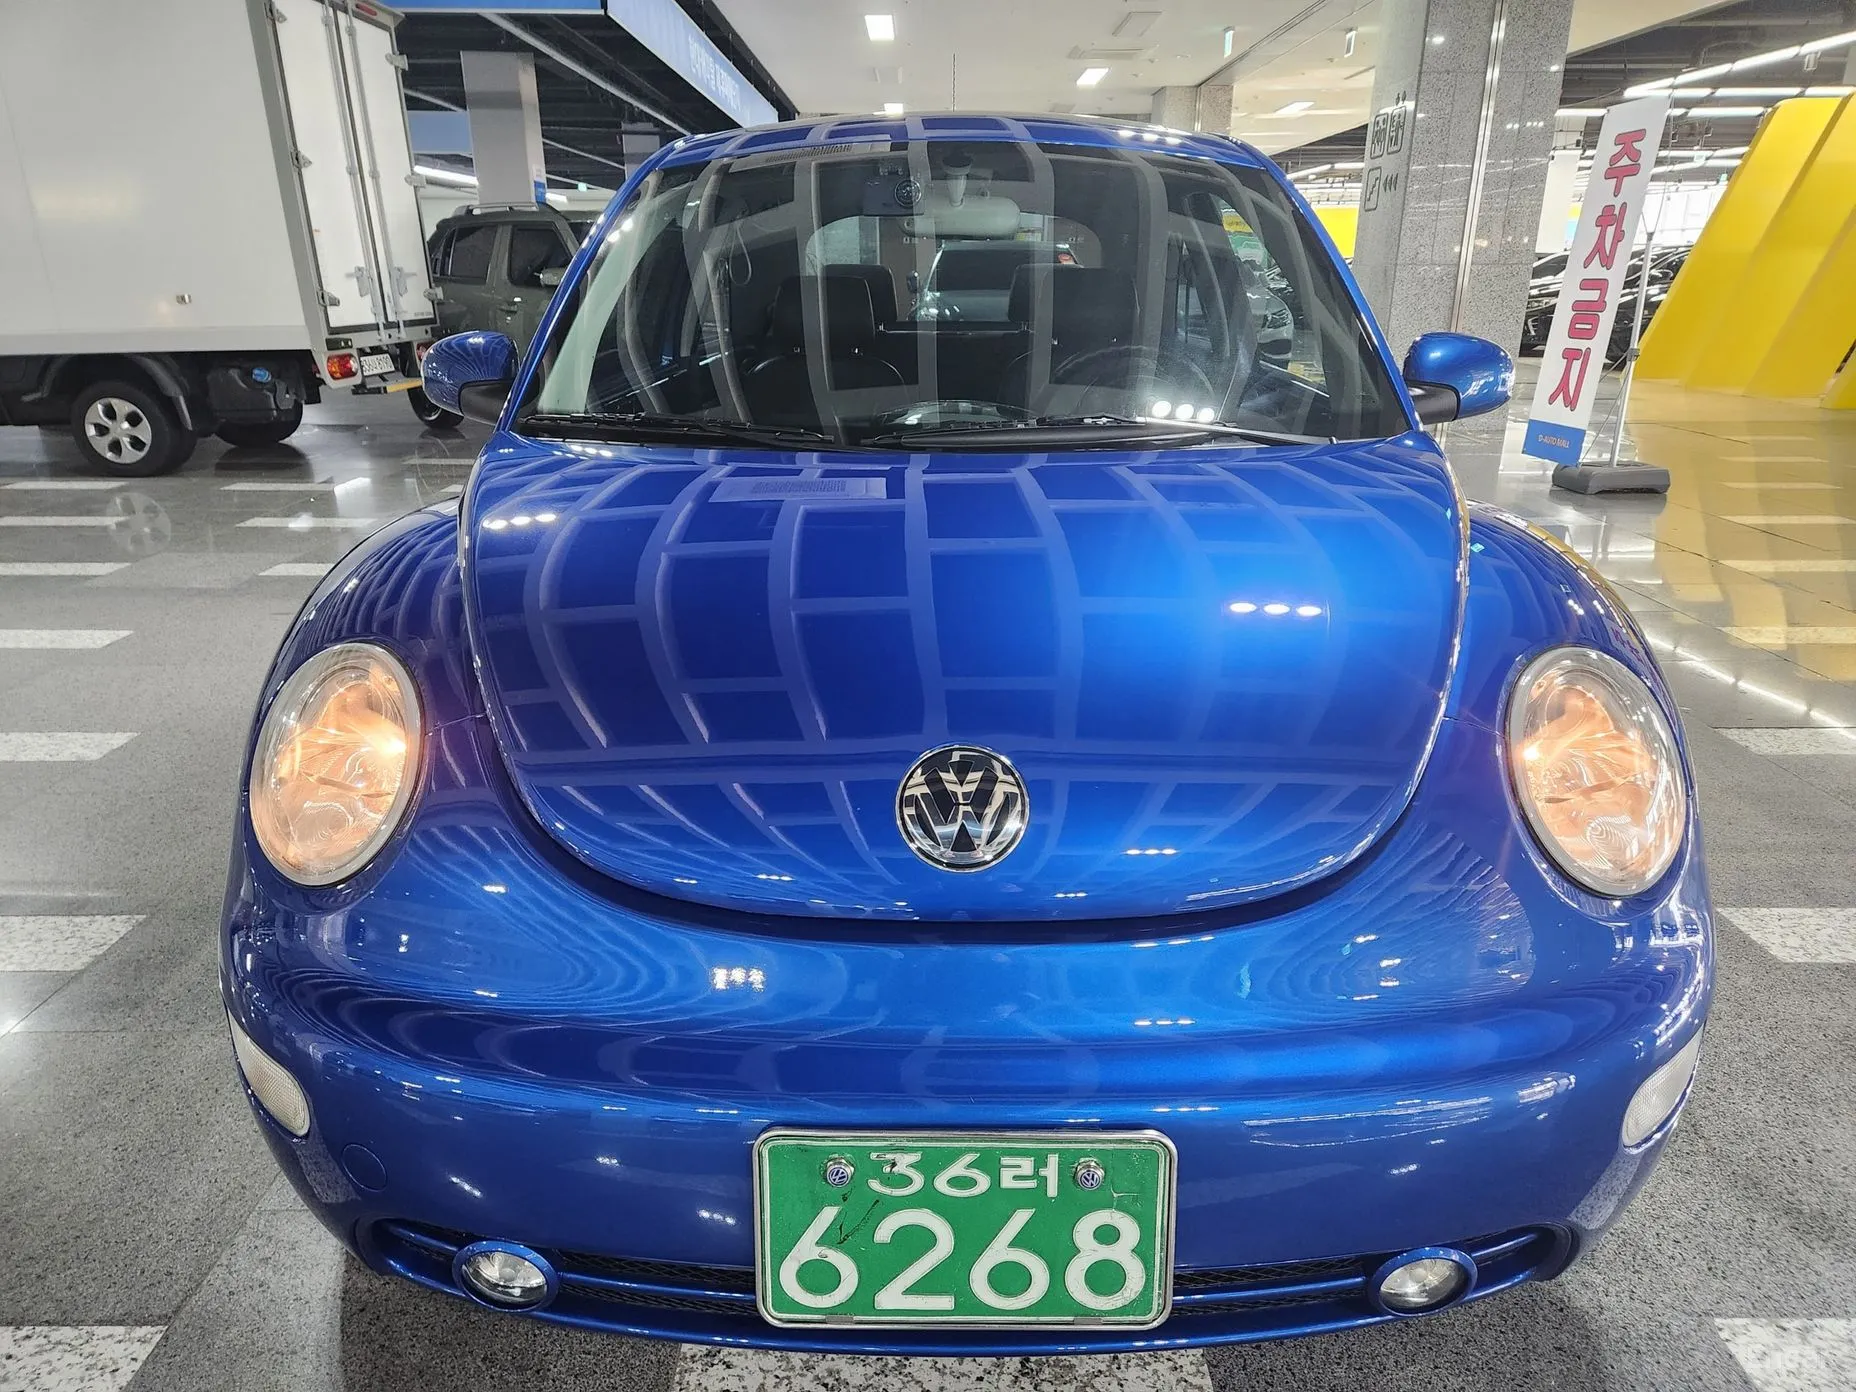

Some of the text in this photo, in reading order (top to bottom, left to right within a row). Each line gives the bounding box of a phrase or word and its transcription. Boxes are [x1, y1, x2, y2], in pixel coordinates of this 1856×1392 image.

[1548, 129, 1646, 411] 주차금지
[867, 1152, 1060, 1198] 36러
[778, 1206, 1146, 1311] 6268
